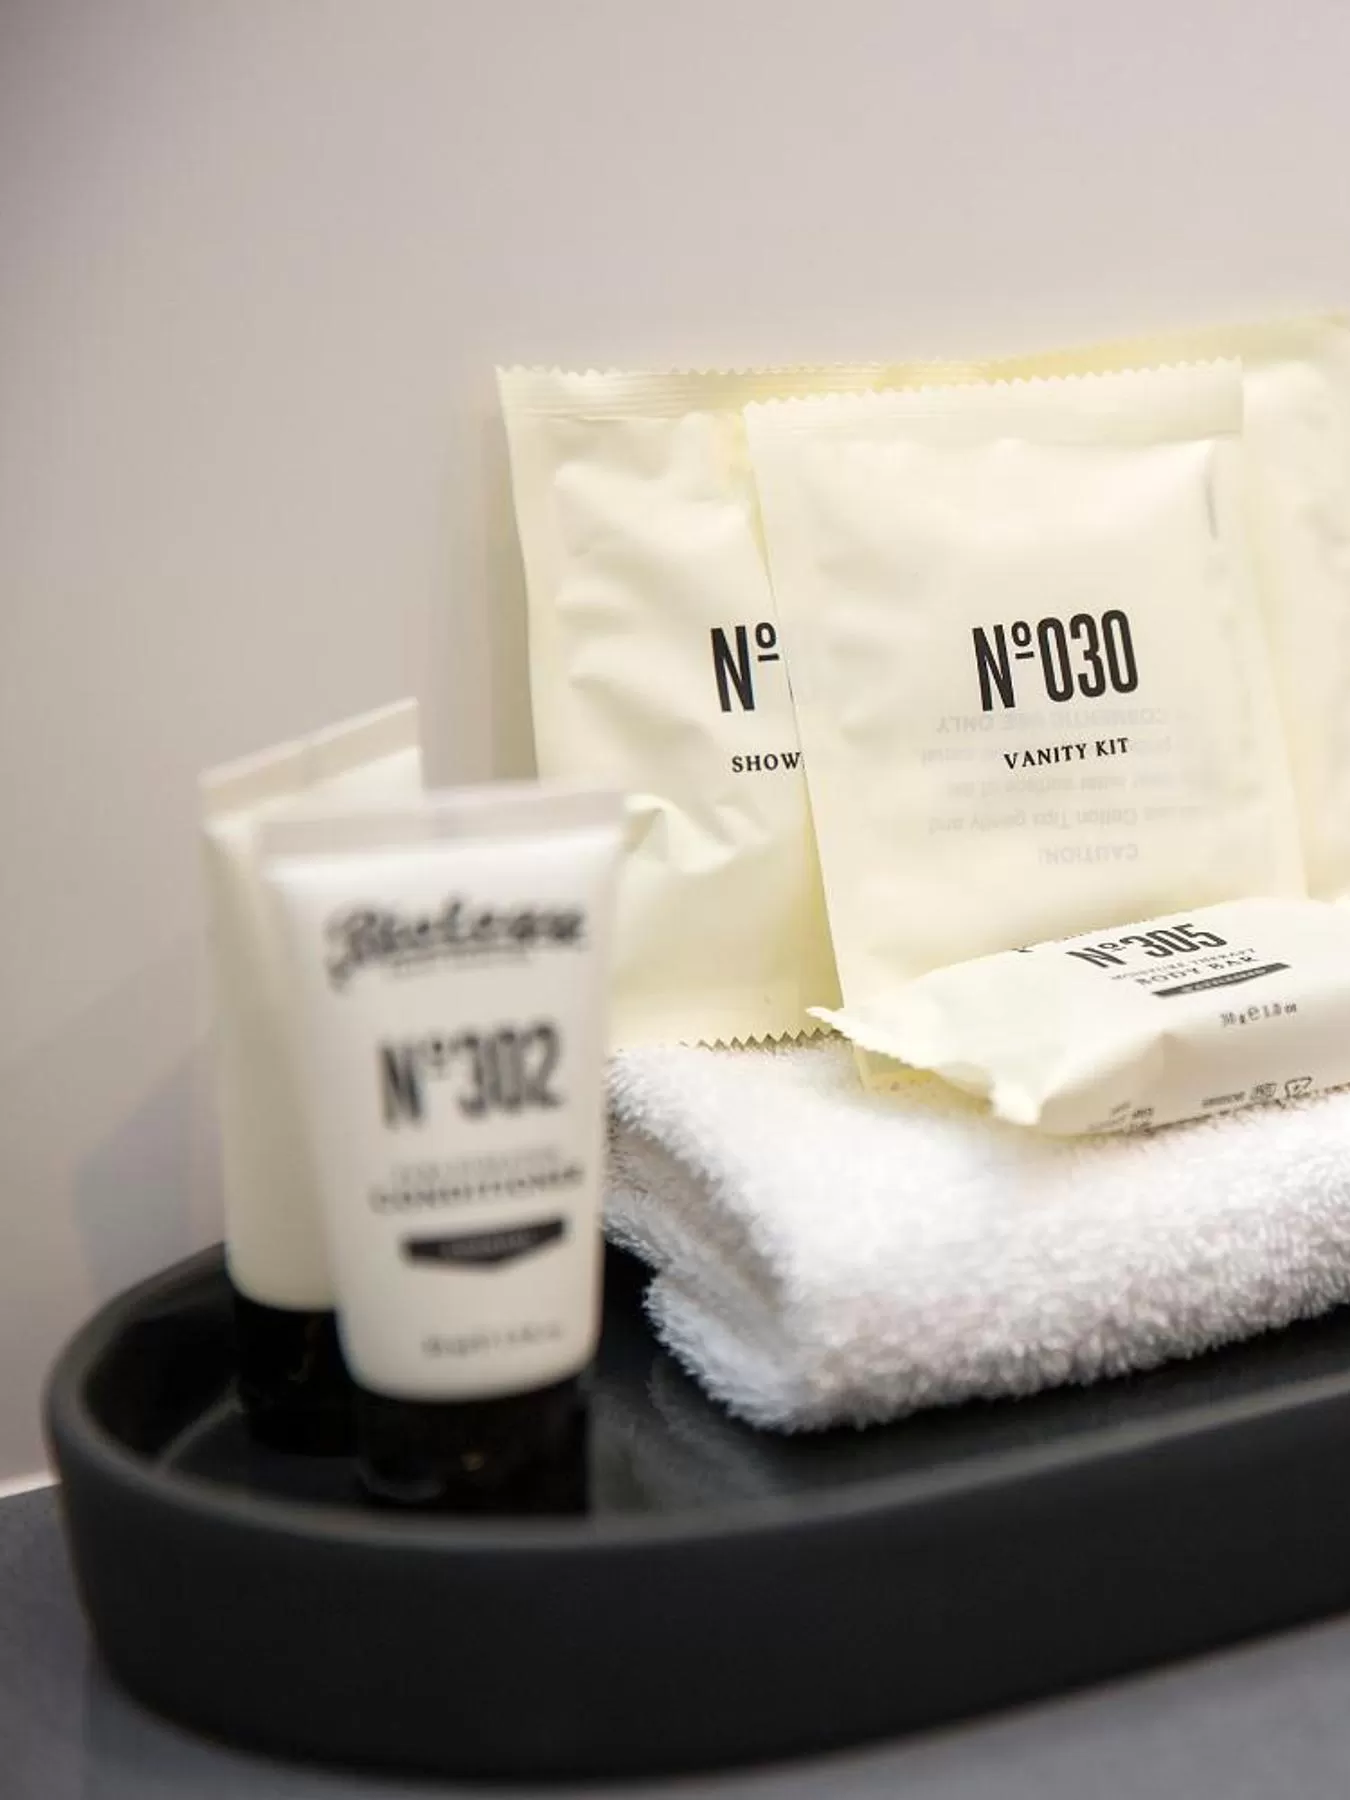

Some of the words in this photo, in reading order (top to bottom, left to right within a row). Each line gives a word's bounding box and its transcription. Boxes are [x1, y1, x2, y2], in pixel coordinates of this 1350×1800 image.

[711, 622, 793, 712] Nº
[731, 751, 804, 773] SHOW
[1004, 743, 1087, 770] VANITY
[1095, 737, 1130, 757] KIT
[1134, 967, 1200, 986] BODY
[1208, 955, 1260, 970] BAR
